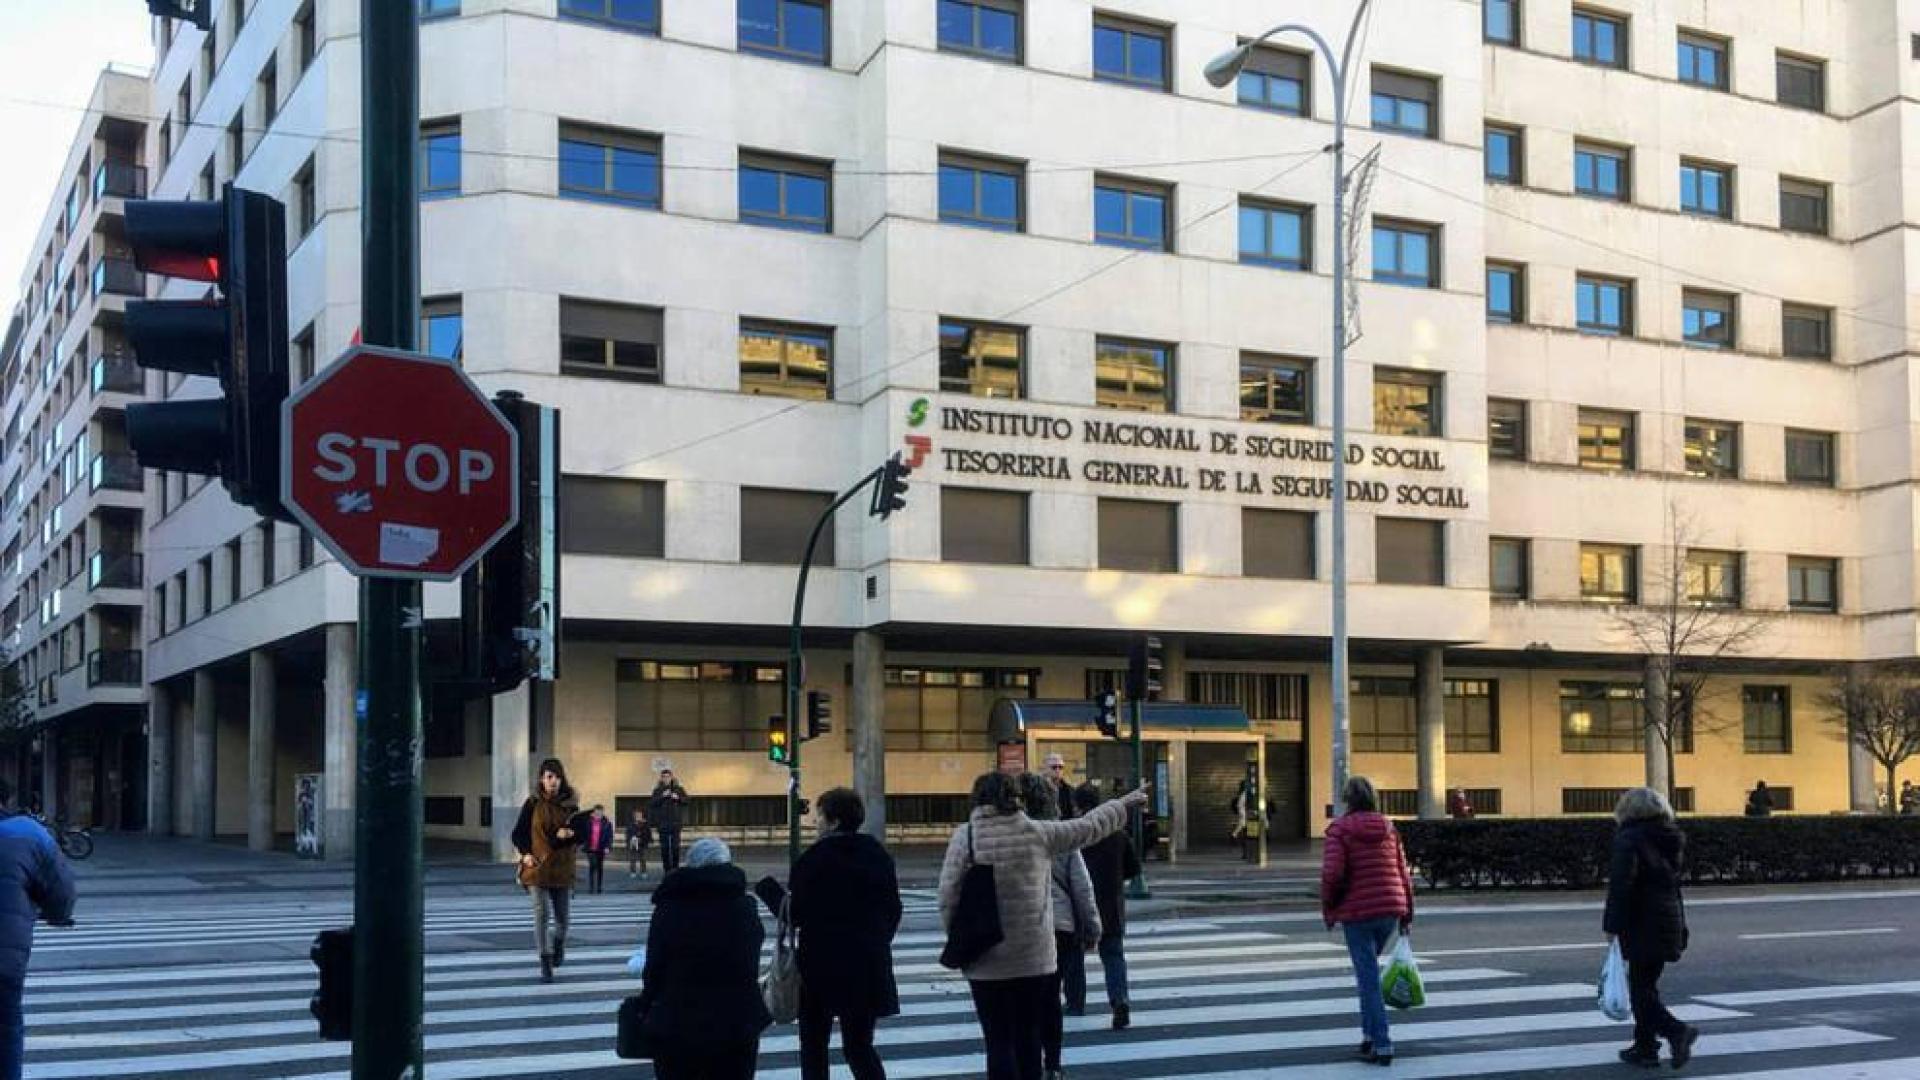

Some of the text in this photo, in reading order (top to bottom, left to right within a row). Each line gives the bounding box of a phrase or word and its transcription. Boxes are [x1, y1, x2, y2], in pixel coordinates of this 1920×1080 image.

[312, 432, 495, 495] STOP
[941, 407, 1446, 471] INSTITUTO NACIONAL DE SEGURIDD SOCIAL
[941, 448, 1072, 480] TESORERIA
[1083, 460, 1189, 489] GENERAL
[1199, 468, 1227, 492] DE
[1236, 471, 1263, 495] LA
[1271, 475, 1389, 503] SEGUDAD
[1397, 484, 1469, 509] SOCIAL
